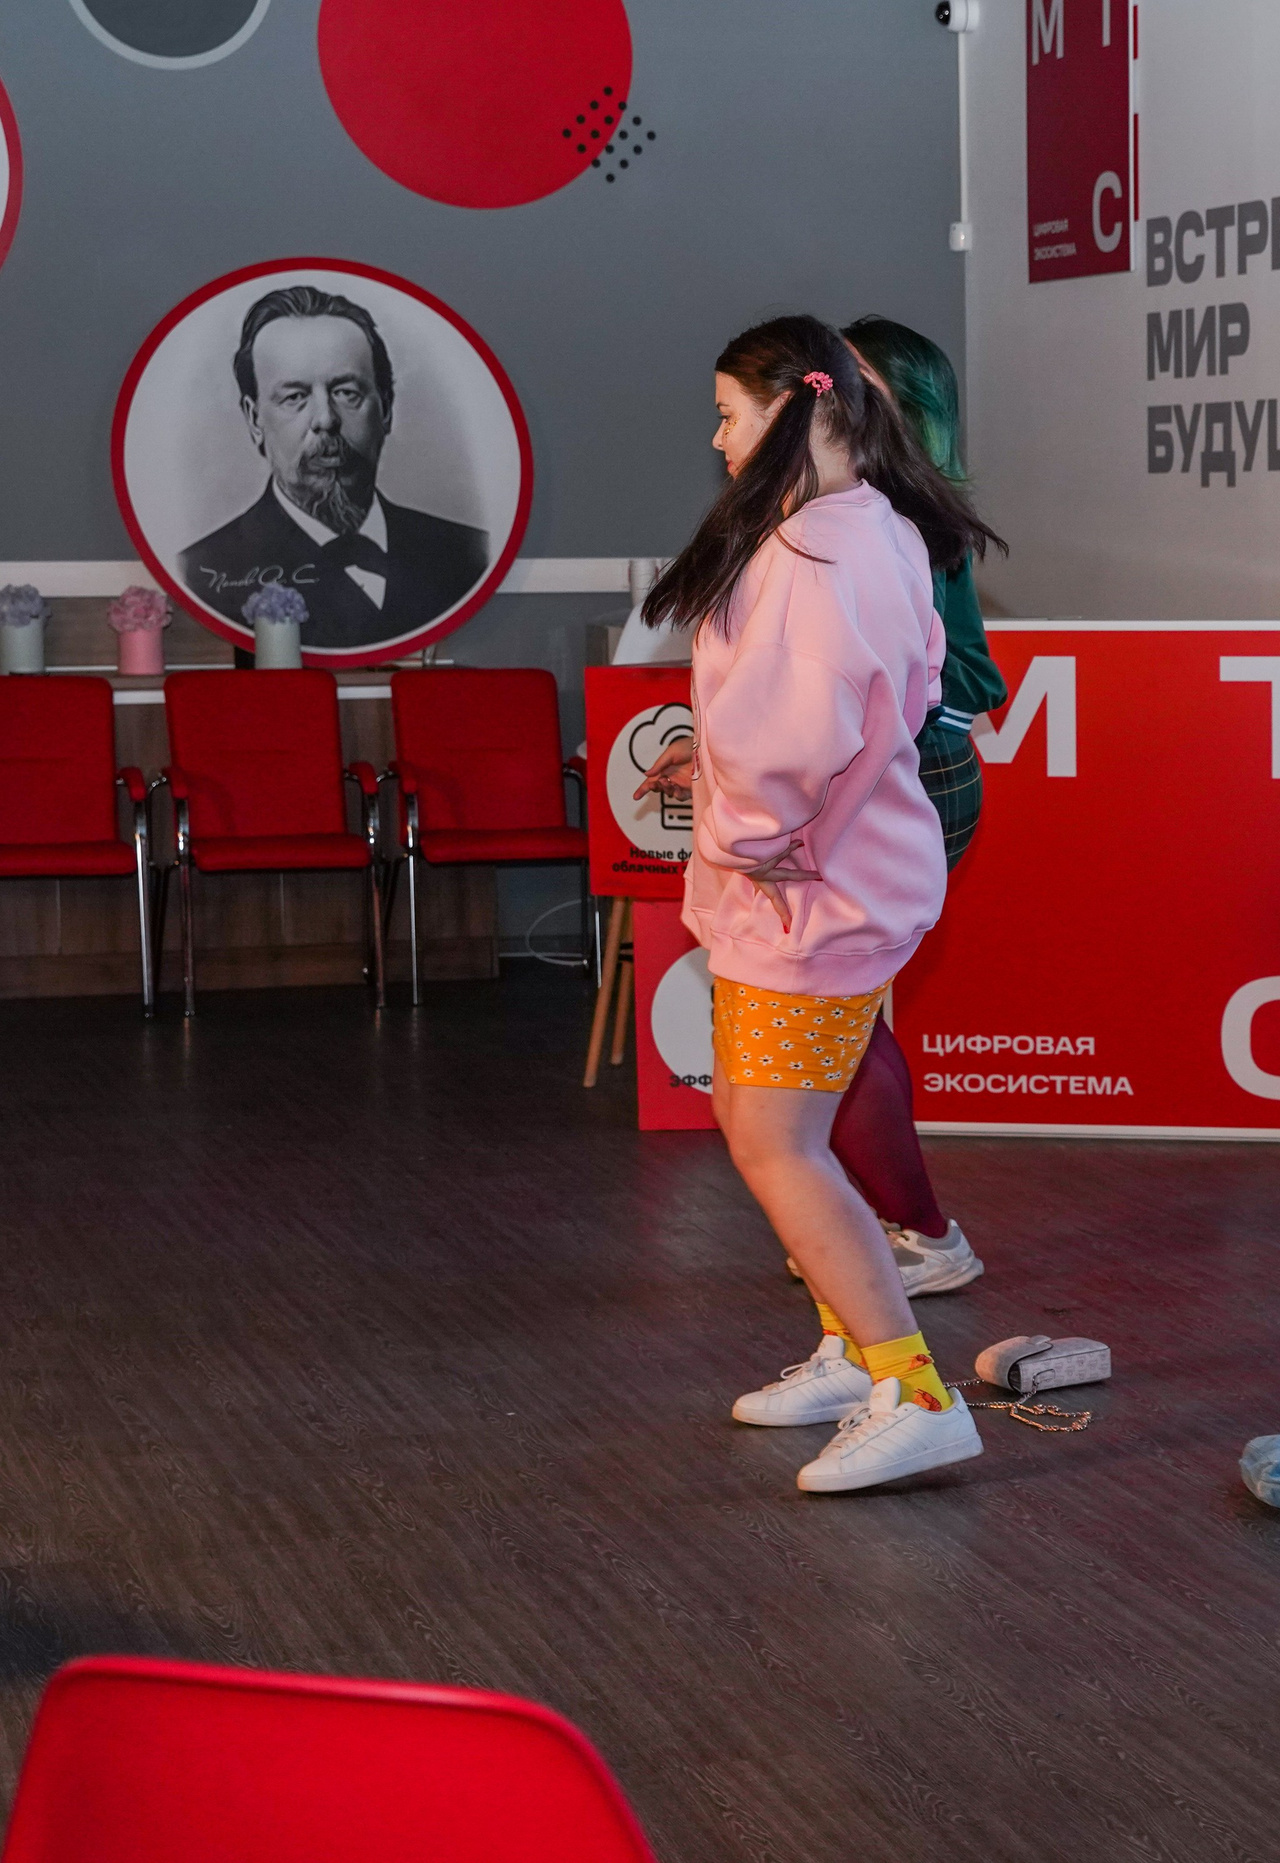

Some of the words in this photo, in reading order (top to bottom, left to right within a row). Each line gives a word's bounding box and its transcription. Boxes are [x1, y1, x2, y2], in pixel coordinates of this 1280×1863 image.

[1147, 302, 1250, 381] МИР
[629, 846, 674, 860] Новые
[612, 860, 679, 875] облачных
[922, 1034, 1096, 1057] ЦИФРОВАЯ
[923, 1072, 1135, 1096] ЭКОСИСТЕМА
